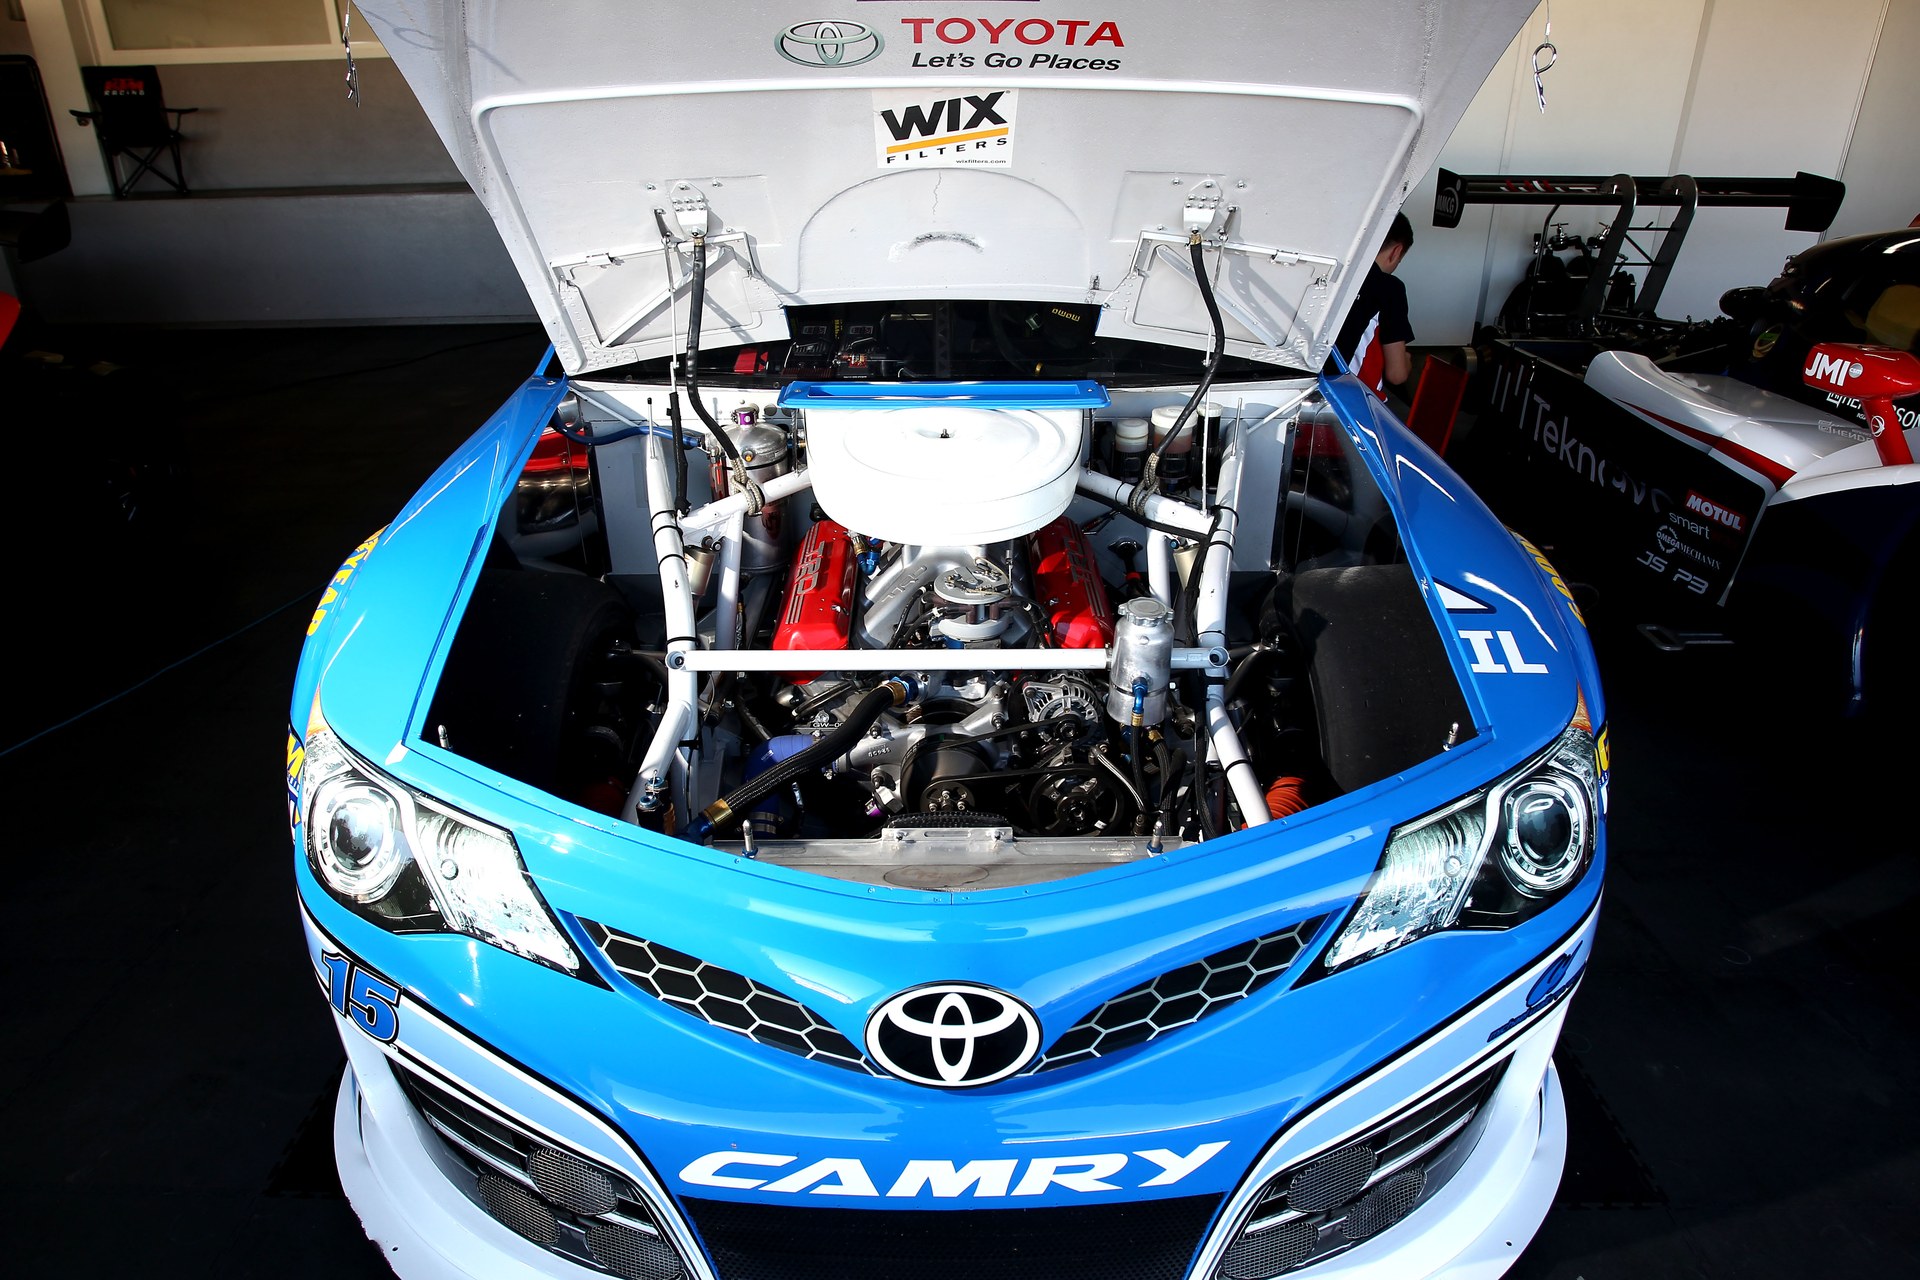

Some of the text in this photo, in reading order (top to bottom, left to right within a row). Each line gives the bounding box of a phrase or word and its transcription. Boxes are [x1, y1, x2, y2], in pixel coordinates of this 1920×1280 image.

[901, 17, 1125, 47] TOYOTA
[912, 52, 1121, 70] Let's Go Places
[880, 91, 1008, 141] WIX
[886, 138, 1007, 164] FILTERS
[1805, 352, 1851, 387] JMI
[1669, 512, 1710, 540] smart
[1686, 494, 1742, 531] MOTUL
[1637, 550, 1709, 594] JS P3
[322, 948, 402, 1044] 15
[678, 1140, 1231, 1198] CAMRY
